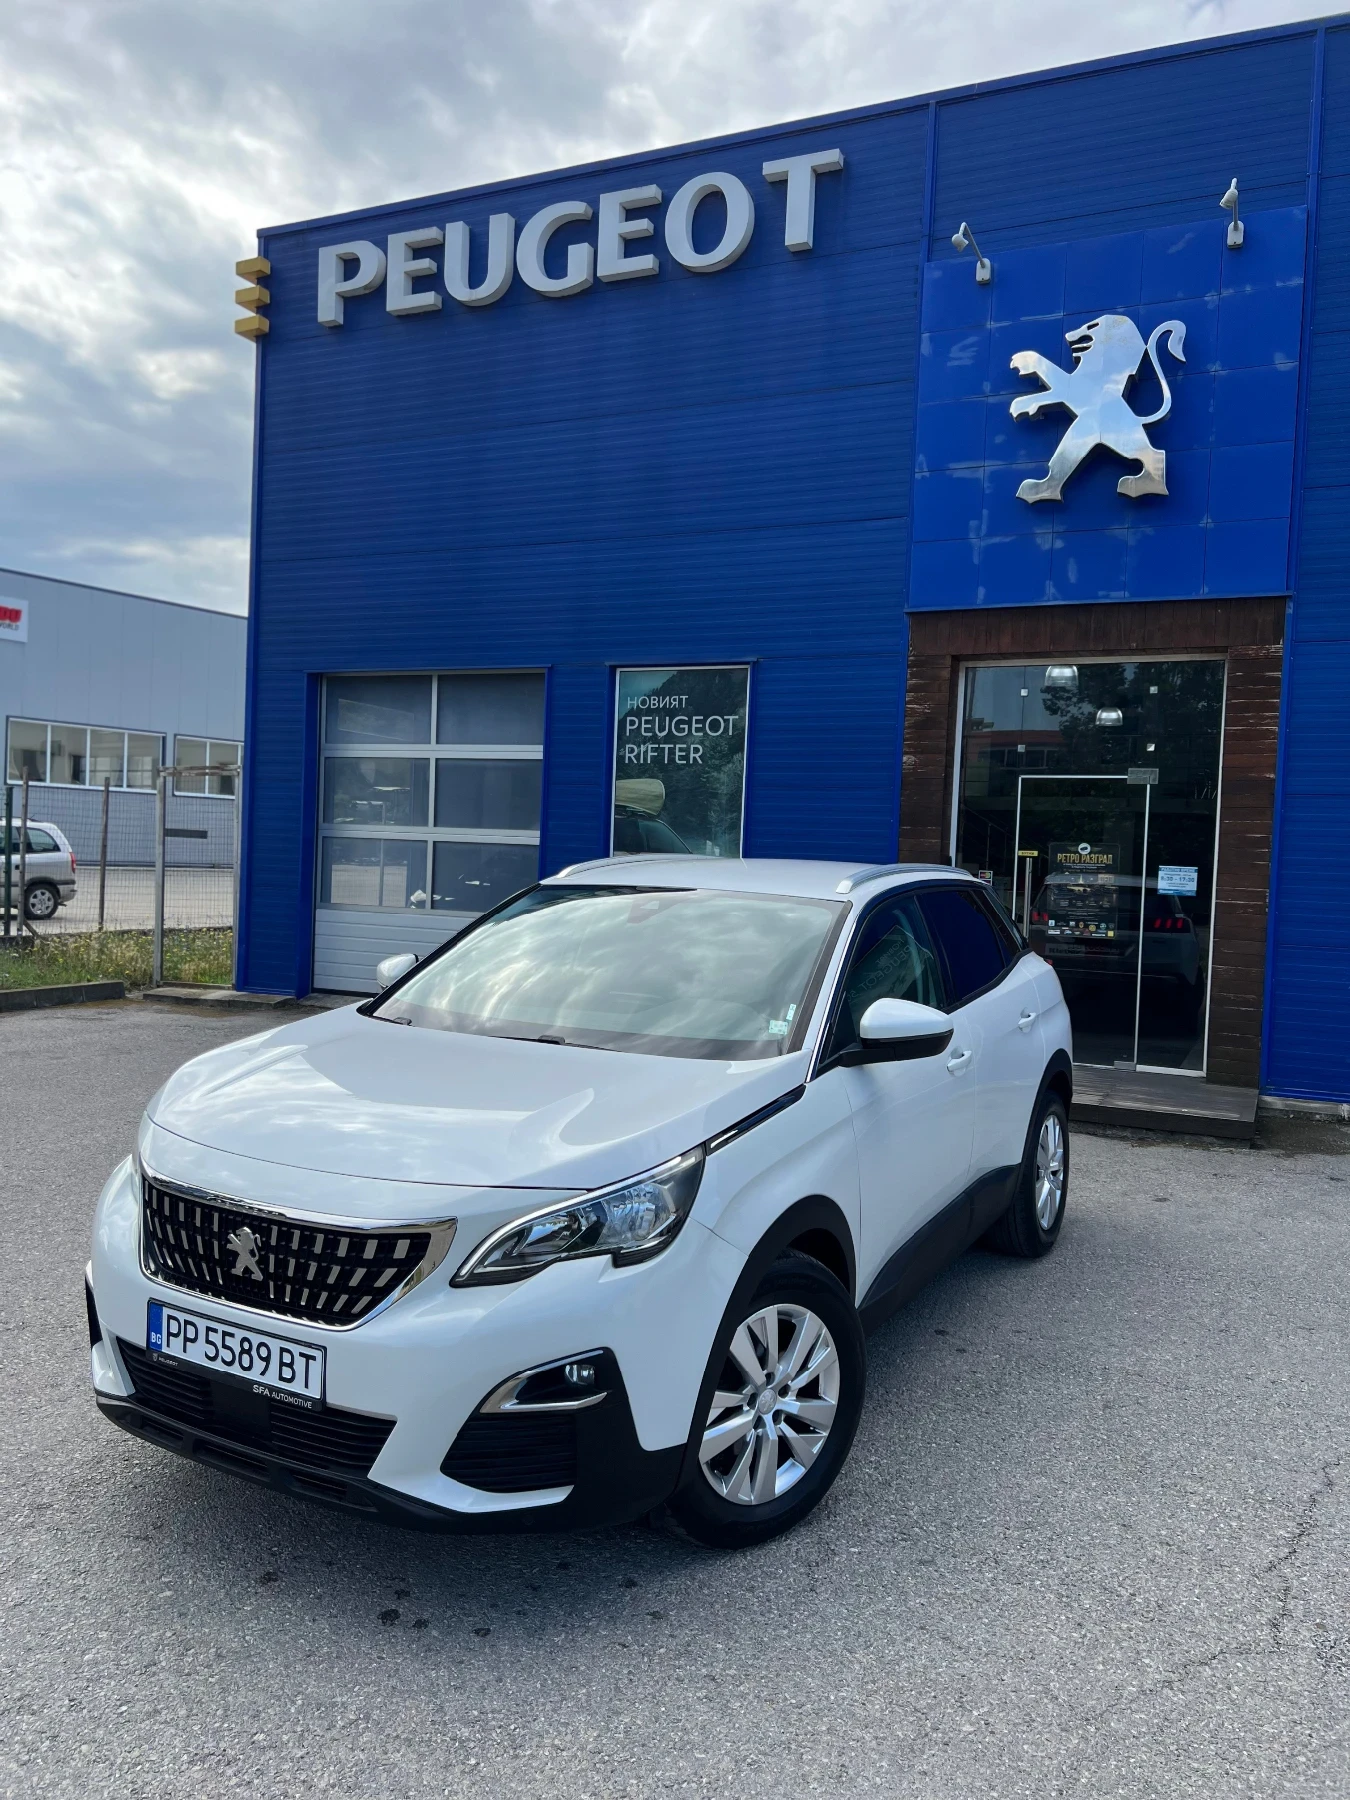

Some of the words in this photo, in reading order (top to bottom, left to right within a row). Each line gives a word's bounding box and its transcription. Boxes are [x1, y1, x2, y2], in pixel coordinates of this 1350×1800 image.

[316, 148, 844, 328] PEUGEOT
[627, 695, 689, 709] НОВИЯТ
[626, 715, 738, 737] PEUGEOT
[625, 744, 703, 764] RIFTER
[1057, 853, 1080, 863] РЕТРО
[1081, 854, 1113, 864] РАЗГРАД
[151, 1331, 162, 1345] BG
[166, 1313, 199, 1354] PP
[204, 1325, 272, 1376] 5589
[278, 1346, 317, 1389] BT
[252, 1384, 270, 1397] SFA
[271, 1391, 313, 1409] AUTOMOTIVE
